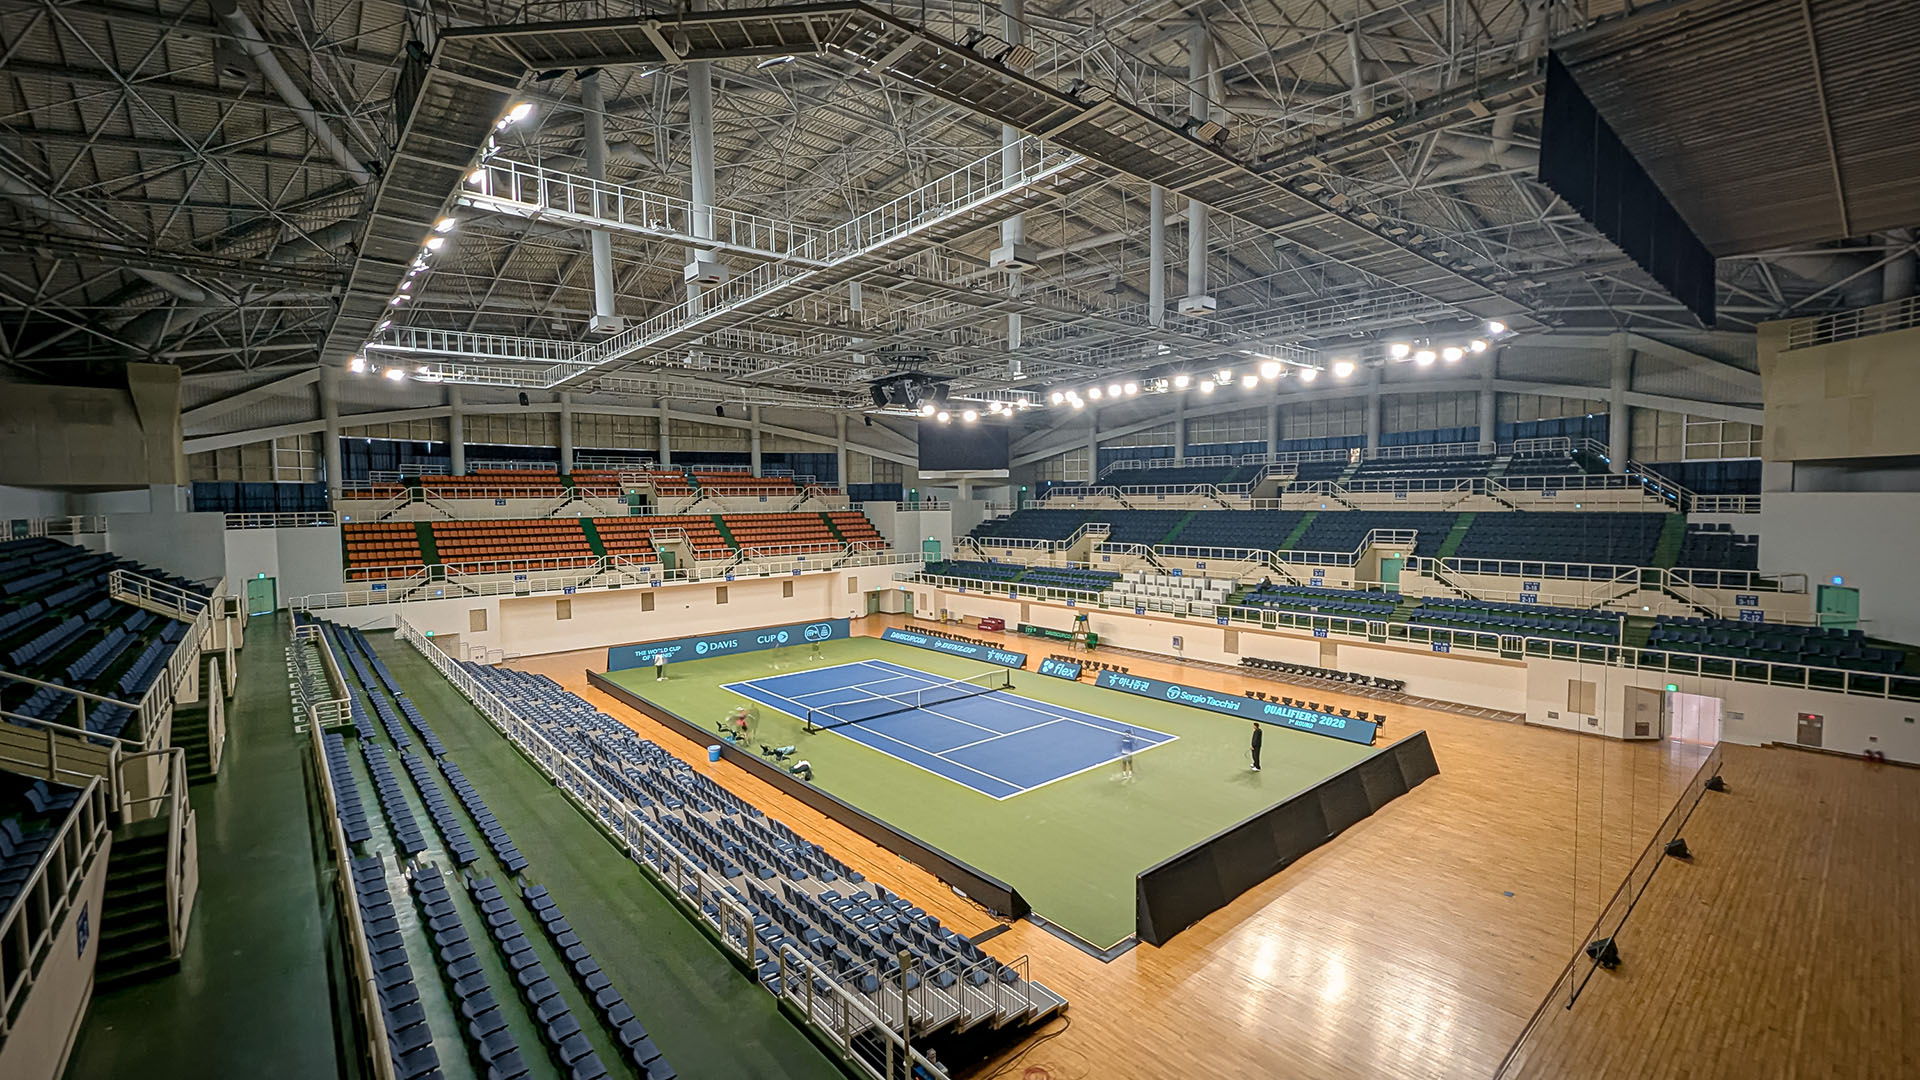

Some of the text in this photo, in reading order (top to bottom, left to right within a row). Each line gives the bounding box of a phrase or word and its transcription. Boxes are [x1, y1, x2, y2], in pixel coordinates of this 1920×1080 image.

[710, 634, 776, 650] DAVIS CUP
[941, 642, 977, 654] DUNLOP
[1053, 664, 1076, 677] flex
[1180, 691, 1240, 711] Sergio Tacchini
[1264, 704, 1346, 729] QUALIFIERS 2026
[1294, 719, 1314, 729] ROUND
